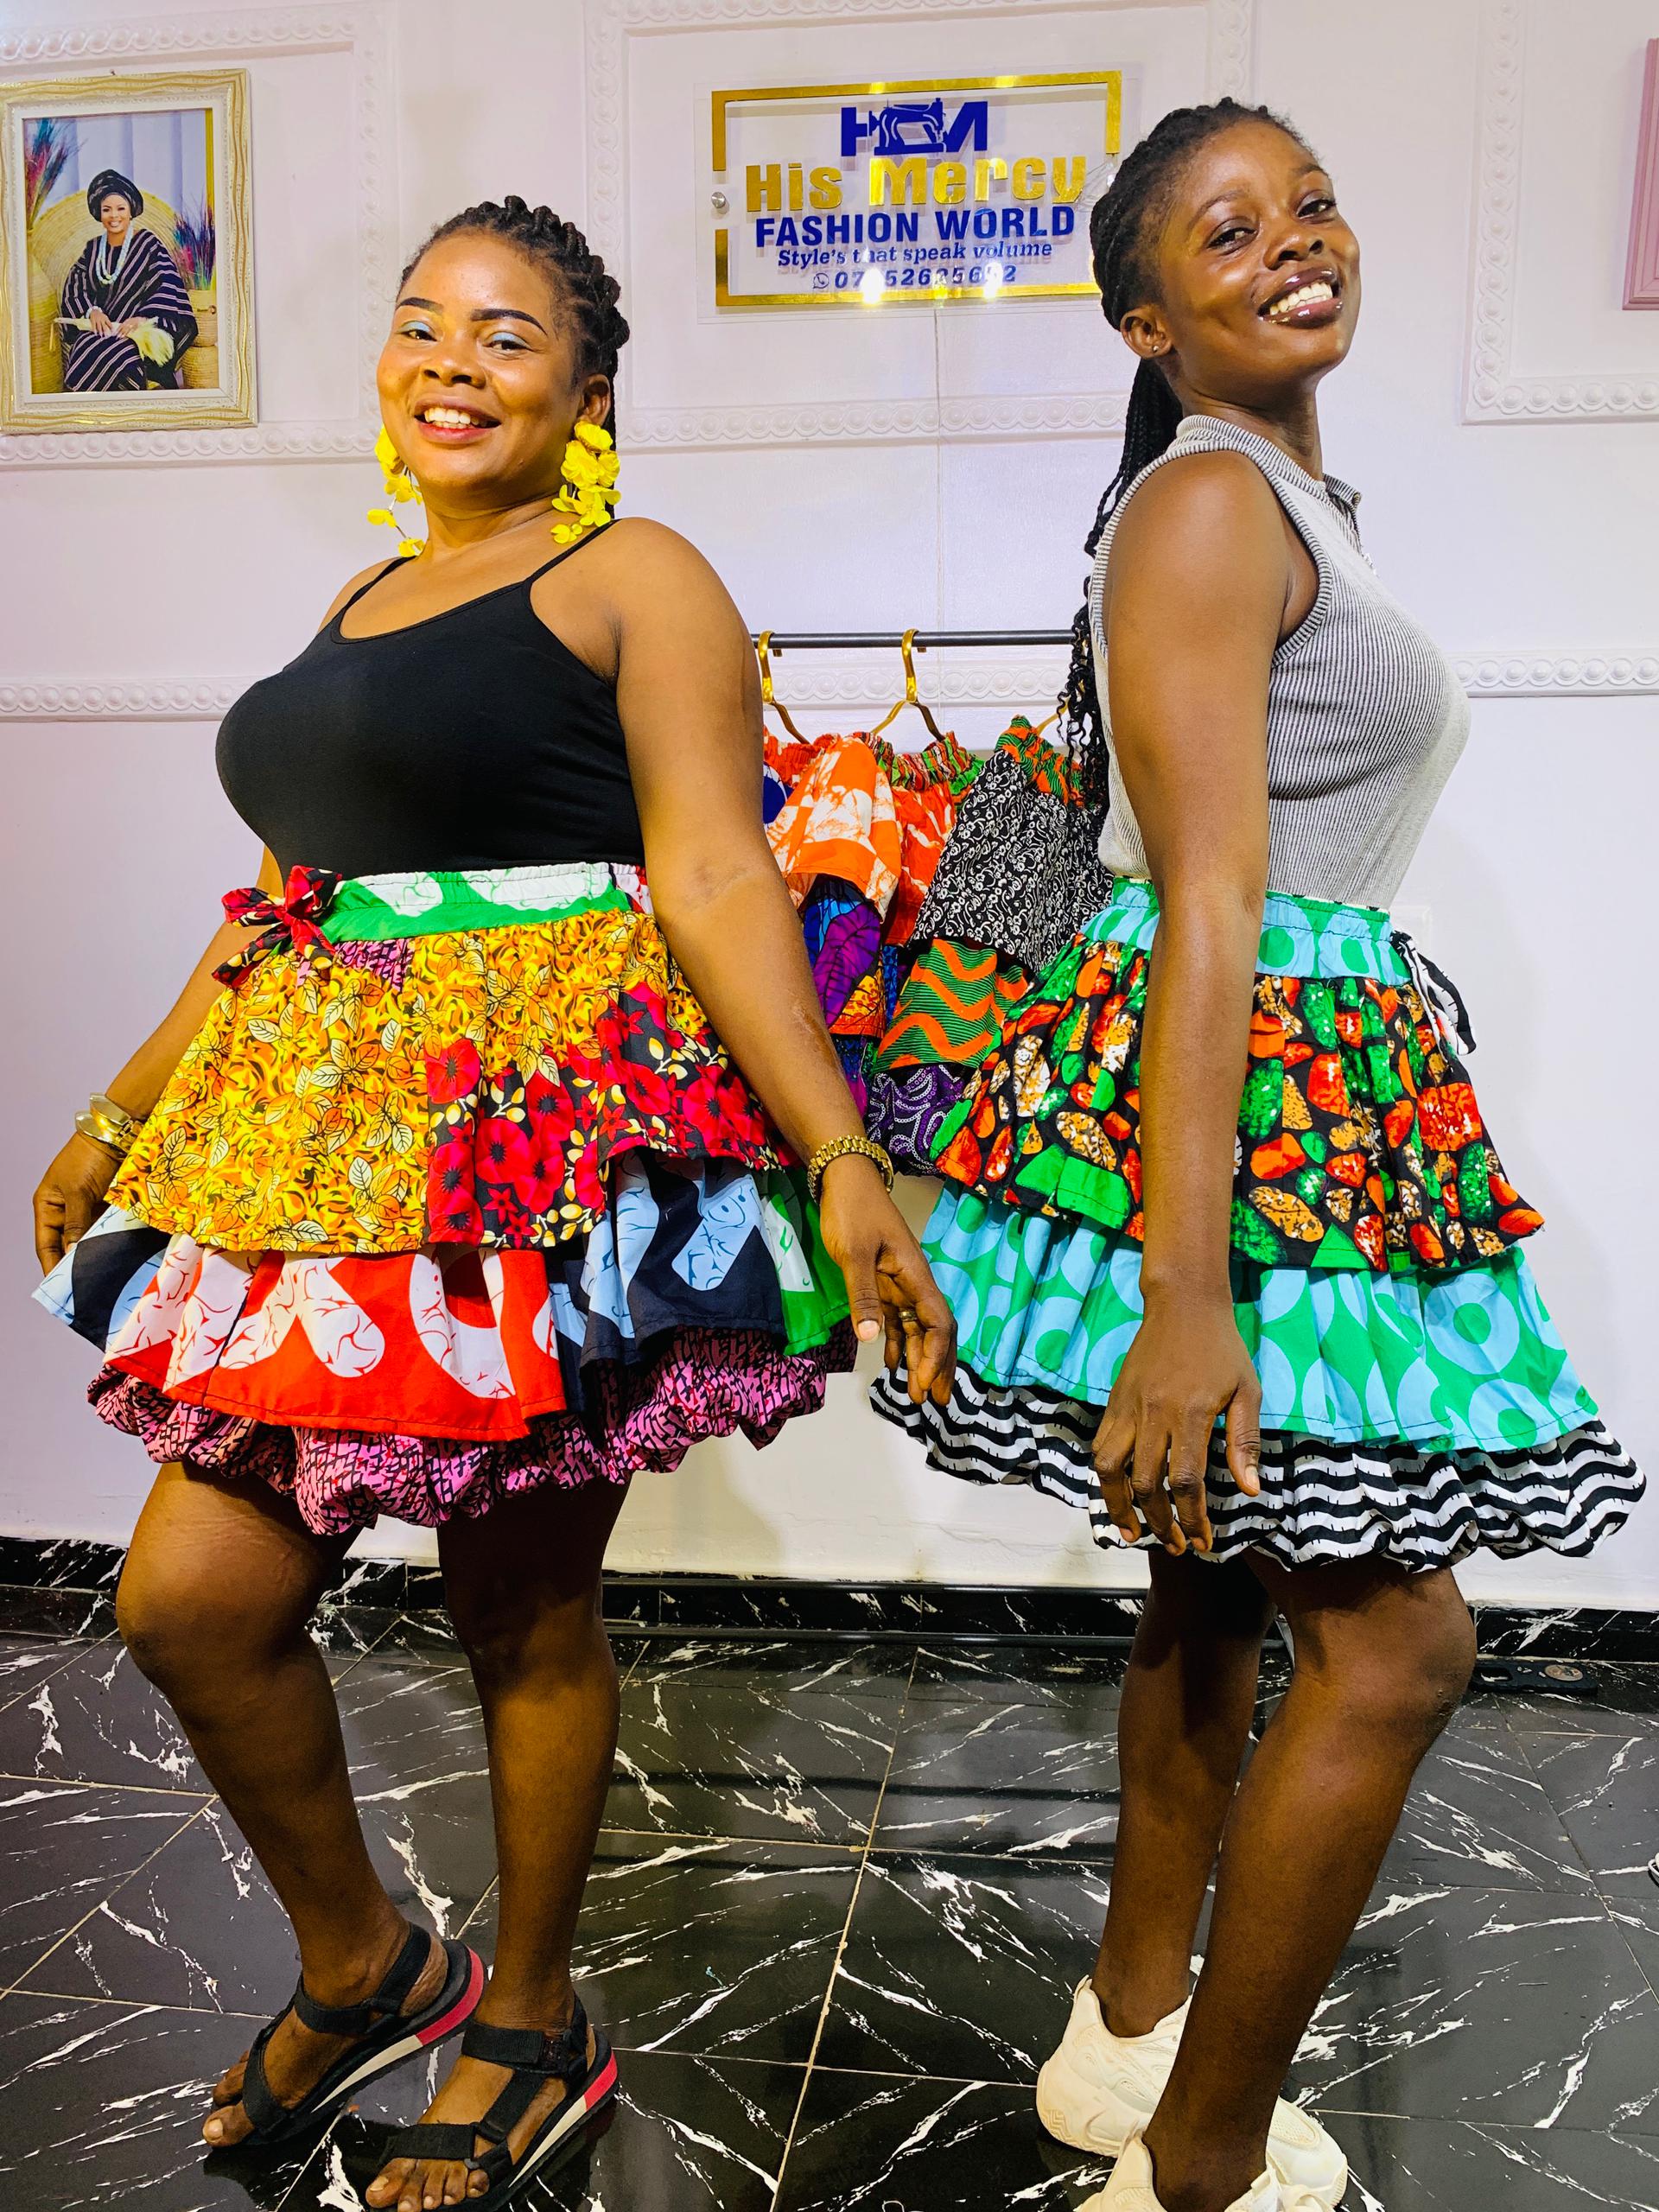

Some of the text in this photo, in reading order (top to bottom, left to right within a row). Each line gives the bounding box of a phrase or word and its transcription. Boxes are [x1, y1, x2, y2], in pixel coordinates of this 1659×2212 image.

[747, 156, 1086, 212] His Mercy
[756, 206, 1075, 247] FASHION WORLD
[778, 241, 1052, 269] Style's that speak volume
